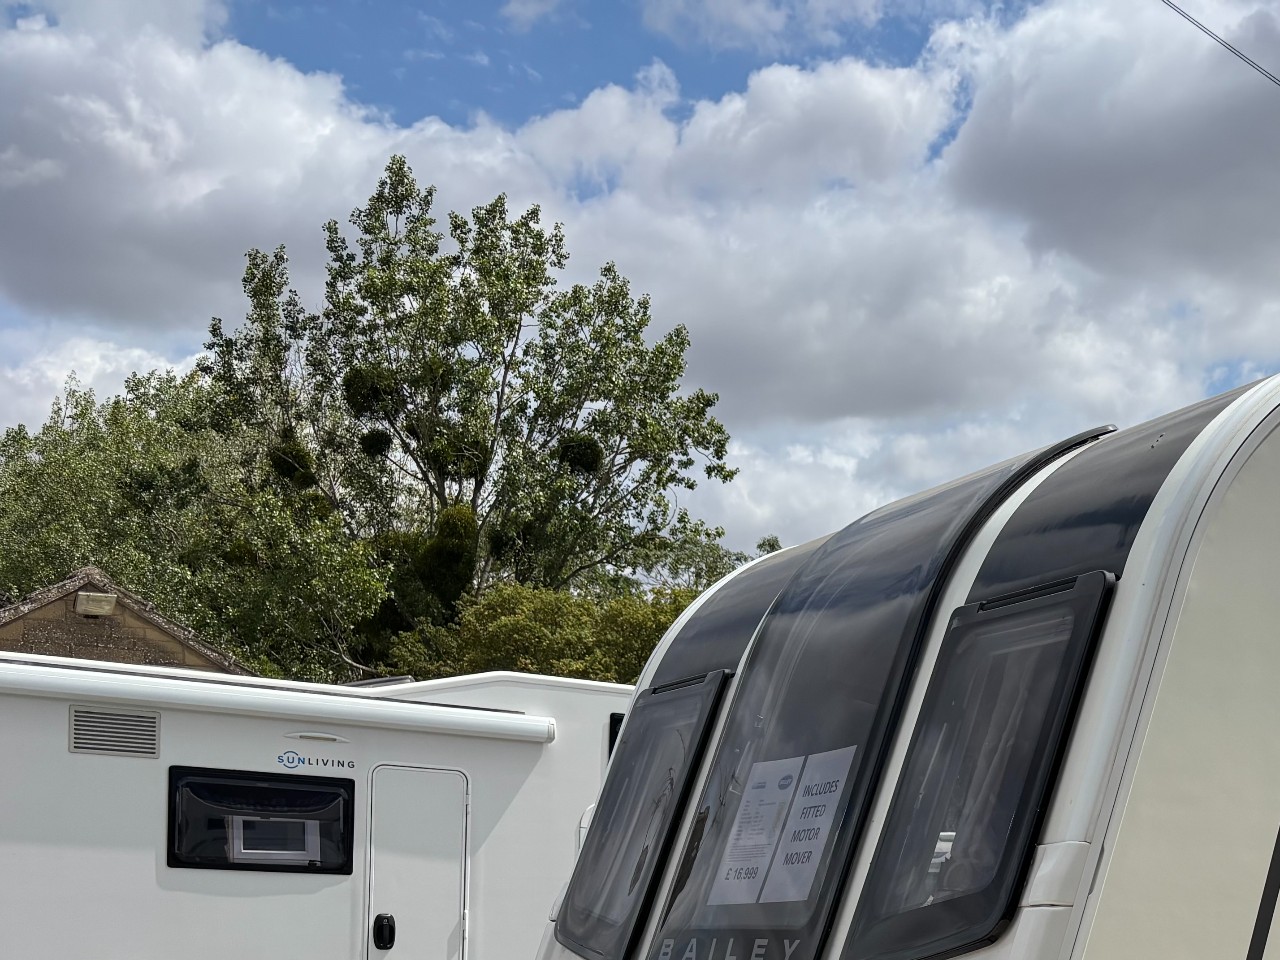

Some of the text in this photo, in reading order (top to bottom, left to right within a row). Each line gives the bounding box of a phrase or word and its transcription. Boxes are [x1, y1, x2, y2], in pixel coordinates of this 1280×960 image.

[277, 754, 355, 769] SUNLIVING
[802, 780, 839, 797] INCLUDES
[800, 804, 826, 819] FITTED
[791, 827, 820, 842] MOTOR
[783, 851, 812, 866] MOVER
